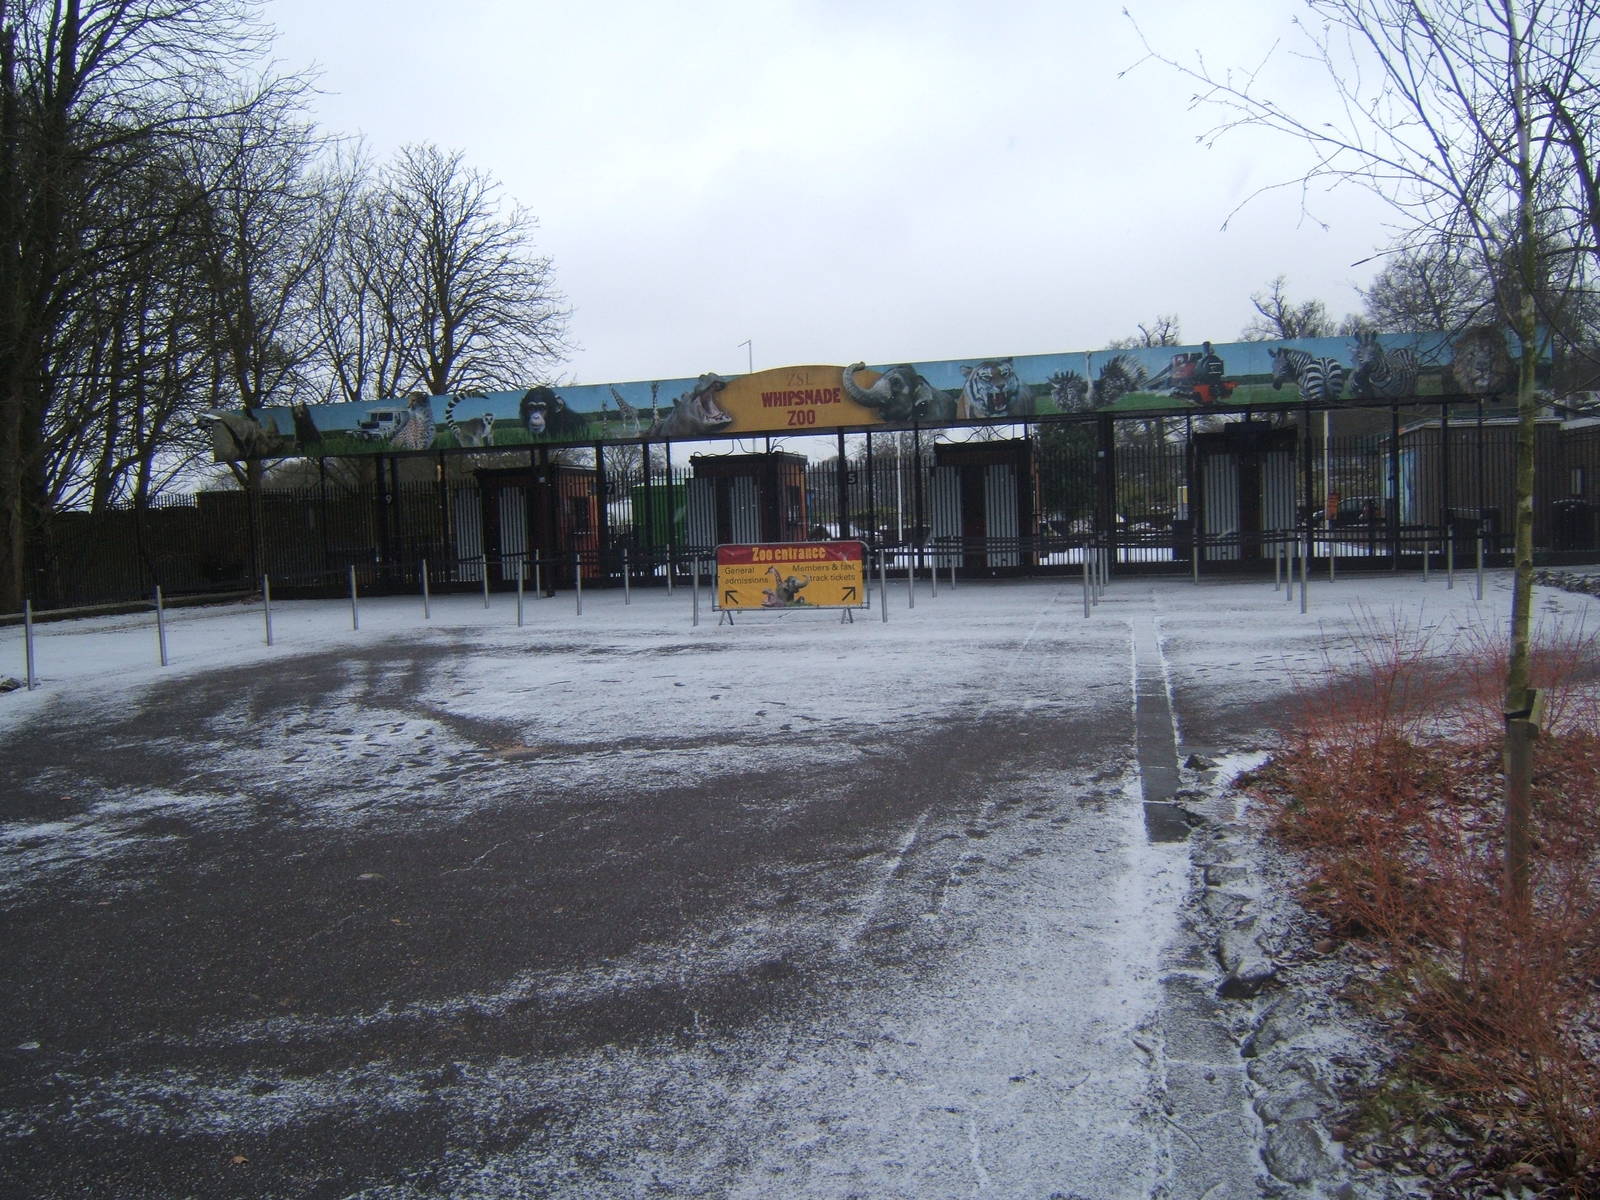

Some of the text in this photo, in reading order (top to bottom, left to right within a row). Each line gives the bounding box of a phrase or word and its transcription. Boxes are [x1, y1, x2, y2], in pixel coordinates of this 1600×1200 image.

[761, 387, 841, 408] WHIPSNADE
[787, 409, 816, 426] ZOO
[752, 546, 827, 562] Zoo entrance
[724, 567, 755, 575] General
[792, 562, 856, 572] Members & fast
[724, 577, 769, 585] admissions
